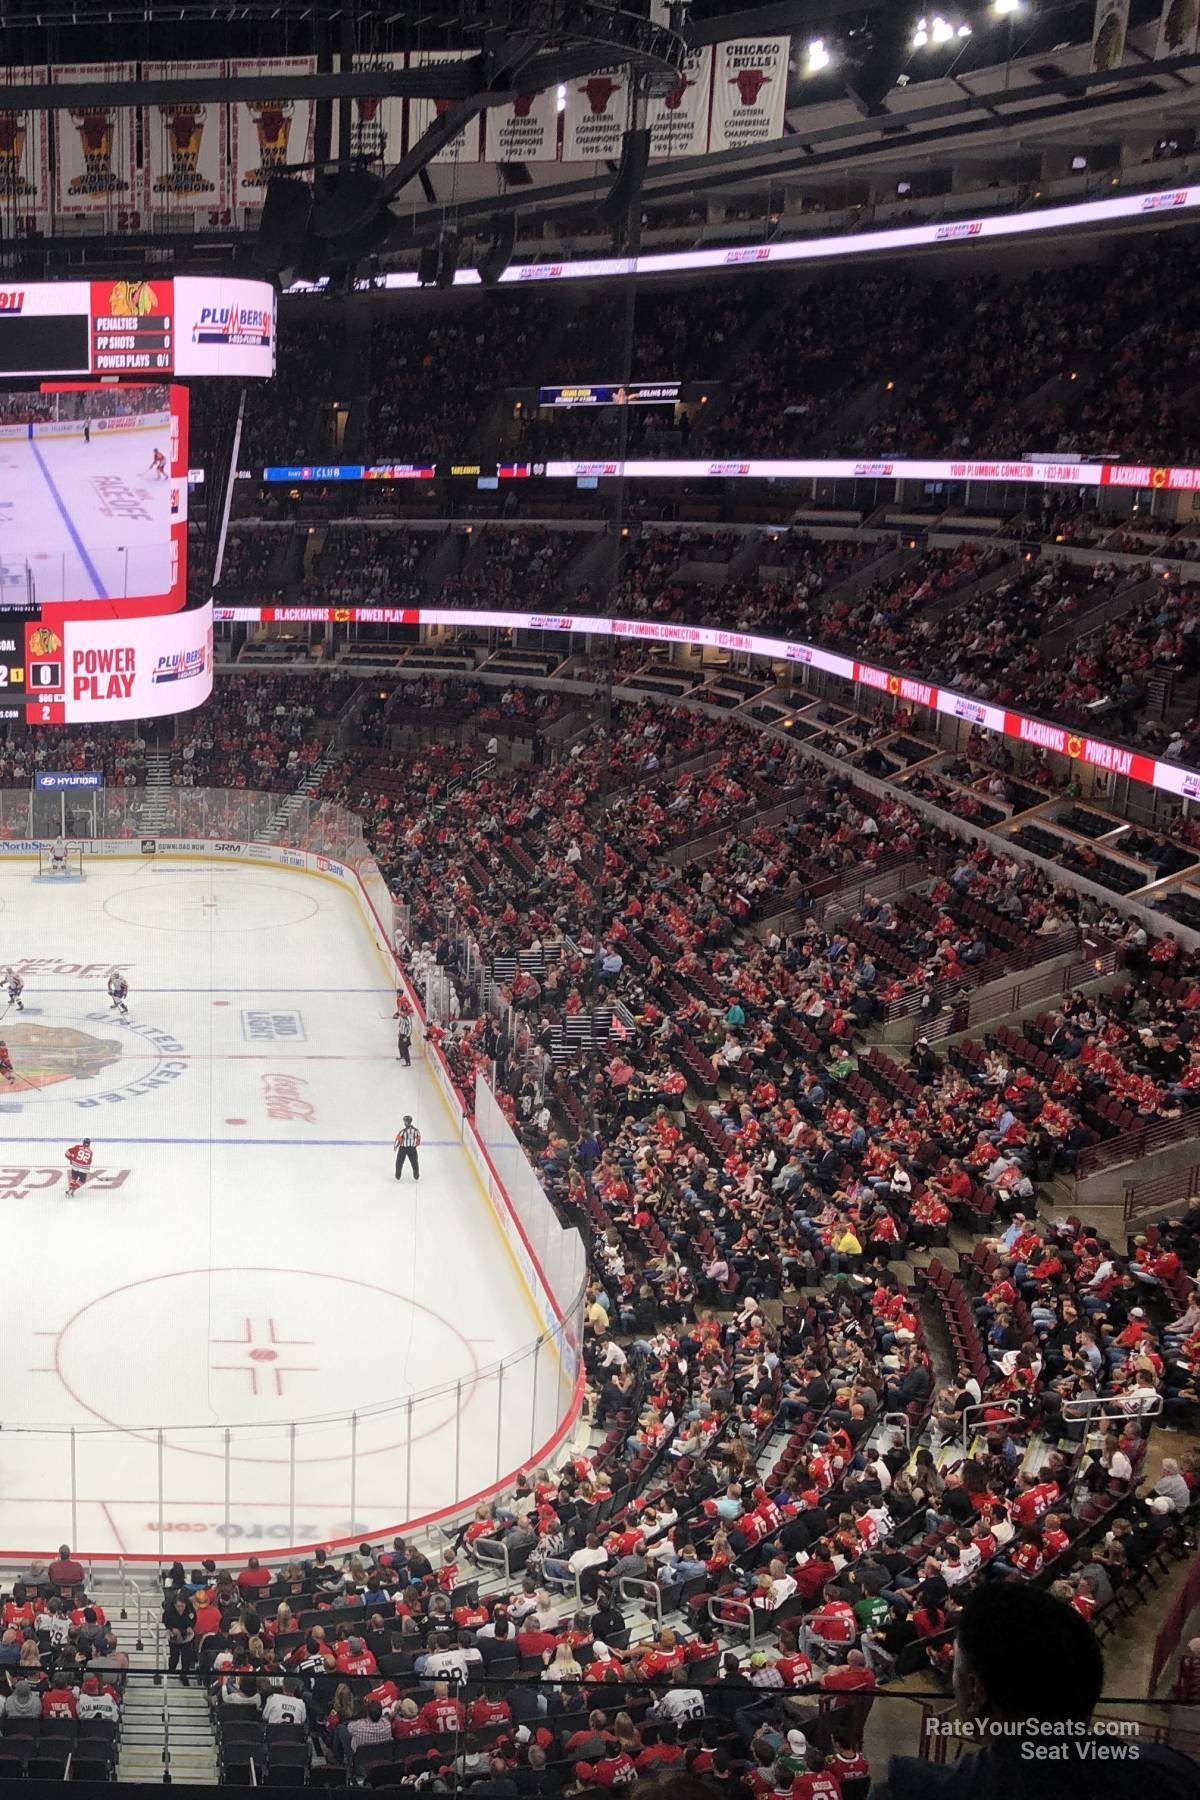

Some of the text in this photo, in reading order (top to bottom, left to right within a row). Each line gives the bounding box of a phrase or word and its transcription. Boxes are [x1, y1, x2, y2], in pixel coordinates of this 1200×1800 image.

[726, 44, 780, 56] CHICAGO
[733, 57, 772, 68] BULLS
[732, 109, 764, 117] EASTERN
[724, 118, 770, 128] CONFERENCE
[575, 134, 620, 145] CHAMPIONS
[724, 128, 769, 139] CHAMPIONS
[499, 138, 544, 147] CHAMPIONS
[68, 182, 129, 195] CHAMPIONS
[153, 183, 215, 193] CHAMPIONS
[117, 212, 141, 229] 23
[96, 316, 170, 330] PENALTIES 0
[97, 336, 170, 349] PP SHOTS 0
[97, 354, 169, 368] POWER PLAYS 0/1
[640, 388, 678, 398] CELINE DION
[316, 467, 340, 478] CLUB
[950, 464, 1033, 478] YOUR PLUMBING CONNECTION
[1110, 466, 1191, 488] BLACKHAWKS POWER
[274, 607, 405, 622] BLACKHAWKS POWER PLAY
[611, 620, 700, 641] YOUR PLUMBING CONNECTION
[73, 647, 135, 674] POWER
[40, 665, 51, 685] 0
[73, 674, 135, 701] PLAY
[859, 664, 932, 704] BLACKHAWKS POWER PLAY
[39, 693, 54, 703] SOG
[42, 706, 50, 720] 2
[1020, 718, 1133, 774] BLACKHAWKS POWER PLAY
[57, 774, 98, 786] HYUNDAI
[158, 843, 205, 851] DOWNLOAD NOW
[214, 842, 241, 853] SRM
[327, 862, 345, 877] bank
[273, 1014, 298, 1036] BUD
[86, 1012, 184, 1053] UNITED
[75, 1061, 188, 1109] CENTER
[77, 1150, 91, 1162] 92
[147, 1521, 319, 1539] zoro.com
[441, 1659, 454, 1667] KANE
[282, 1703, 296, 1712] KEITH
